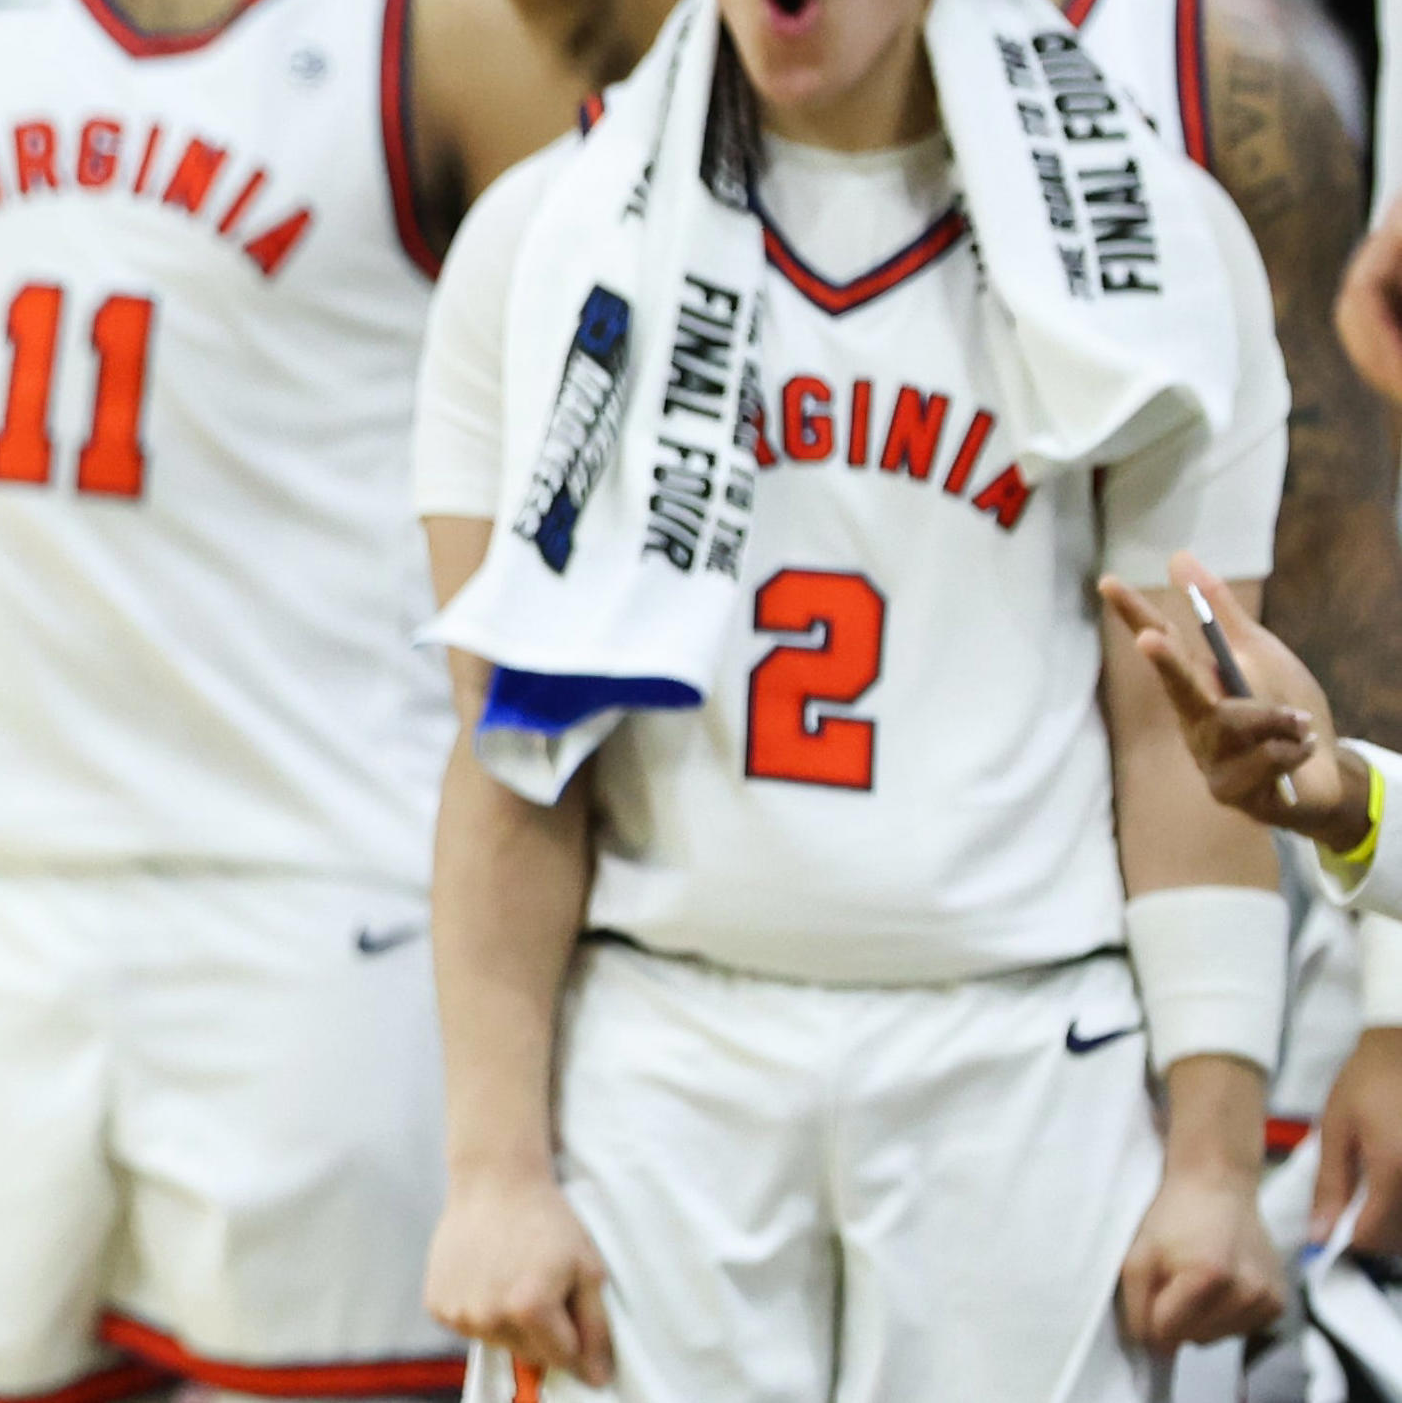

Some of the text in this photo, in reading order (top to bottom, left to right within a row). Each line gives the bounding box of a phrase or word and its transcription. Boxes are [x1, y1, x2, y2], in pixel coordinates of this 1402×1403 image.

[1078, 156, 1161, 294] FINAL
[642, 274, 739, 572] FINAL FOUR
[745, 569, 885, 792] 2
